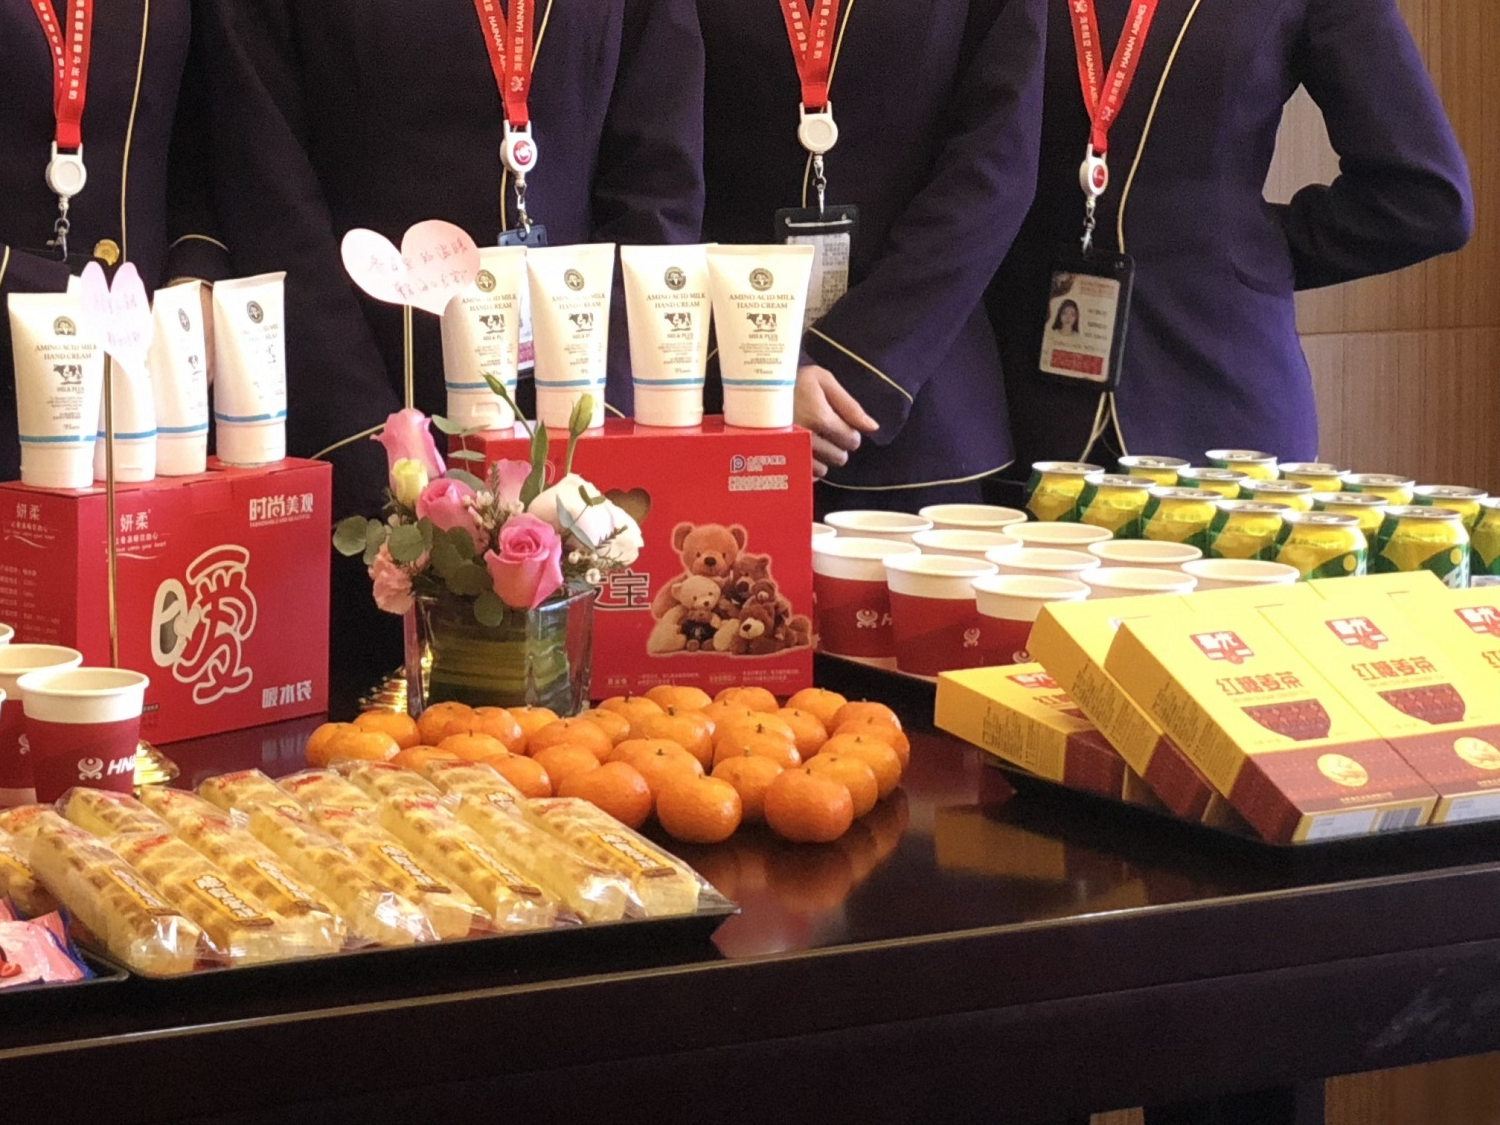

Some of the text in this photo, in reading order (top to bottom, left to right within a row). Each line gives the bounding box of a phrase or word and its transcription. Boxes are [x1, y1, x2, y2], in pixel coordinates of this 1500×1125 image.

[516, 0, 525, 33] HAINAN
[487, 15, 506, 52] HAINAN
[1120, 35, 1138, 69] HAINAN
[1130, 2, 1148, 37] AIRLINES
[1084, 49, 1098, 83] HAINAN
[654, 301, 675, 309] HAND
[737, 302, 760, 310] HAND
[775, 293, 796, 301] MILK
[44, 352, 92, 361] HAND CREAM
[249, 492, 314, 521] 时尚美观
[119, 513, 150, 532] 妍柔
[1351, 655, 1438, 681] 红糖姜茶
[1216, 671, 1304, 696] 红糖姜茶
[107, 754, 136, 775] HN
